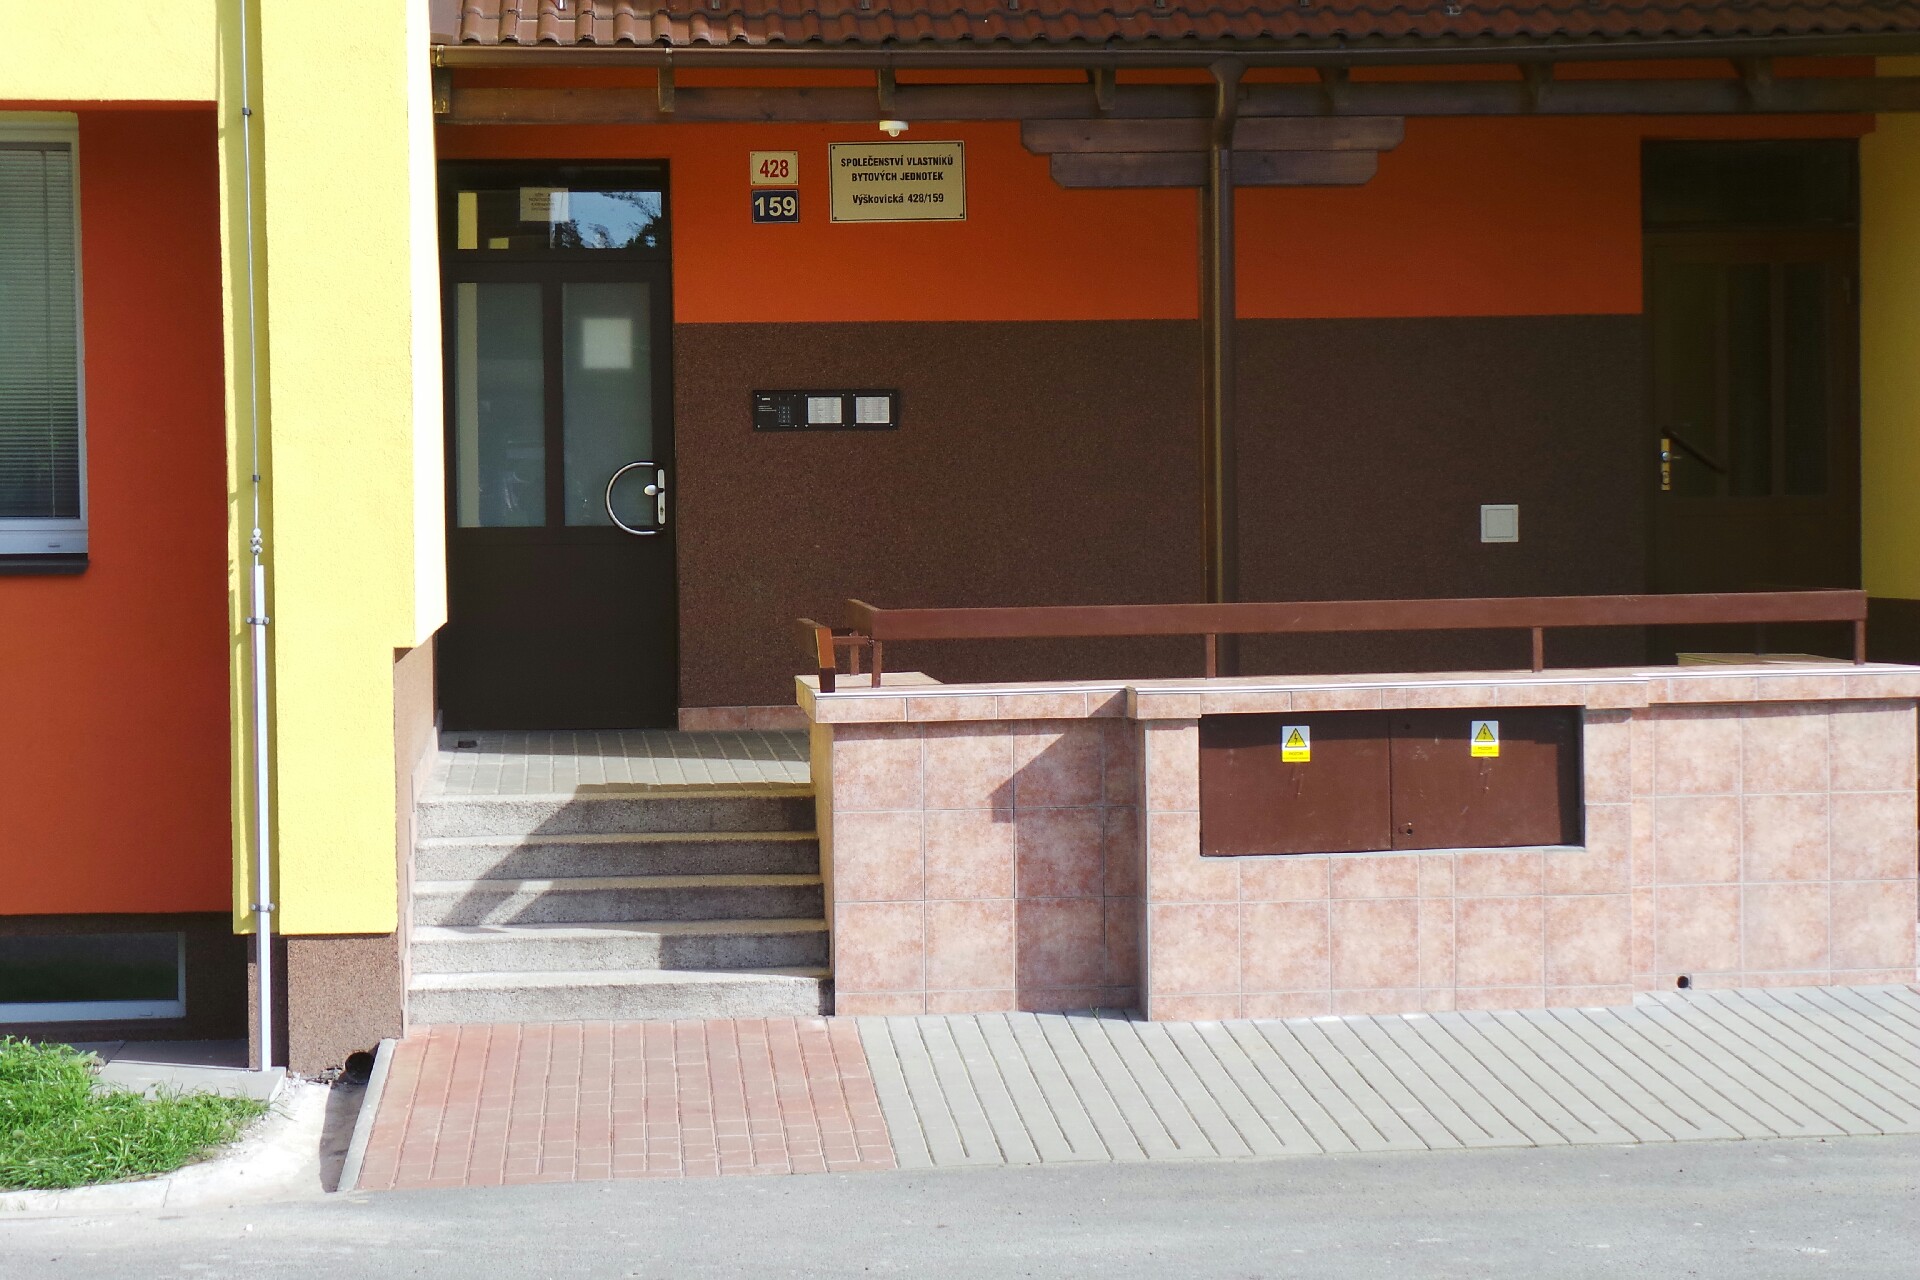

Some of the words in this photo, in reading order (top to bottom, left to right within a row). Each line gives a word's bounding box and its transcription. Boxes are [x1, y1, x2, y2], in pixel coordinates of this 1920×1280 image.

[841, 155, 903, 167] SPOLEČENSTVÍ
[907, 154, 954, 166] VLASTNÍKŮ
[760, 159, 789, 178] 428
[851, 170, 897, 181] BYTOVÝCH
[900, 171, 944, 181] JEDNOTEK
[852, 193, 904, 205] Výškovická
[907, 193, 944, 203] 428/159
[755, 196, 796, 217] 159
